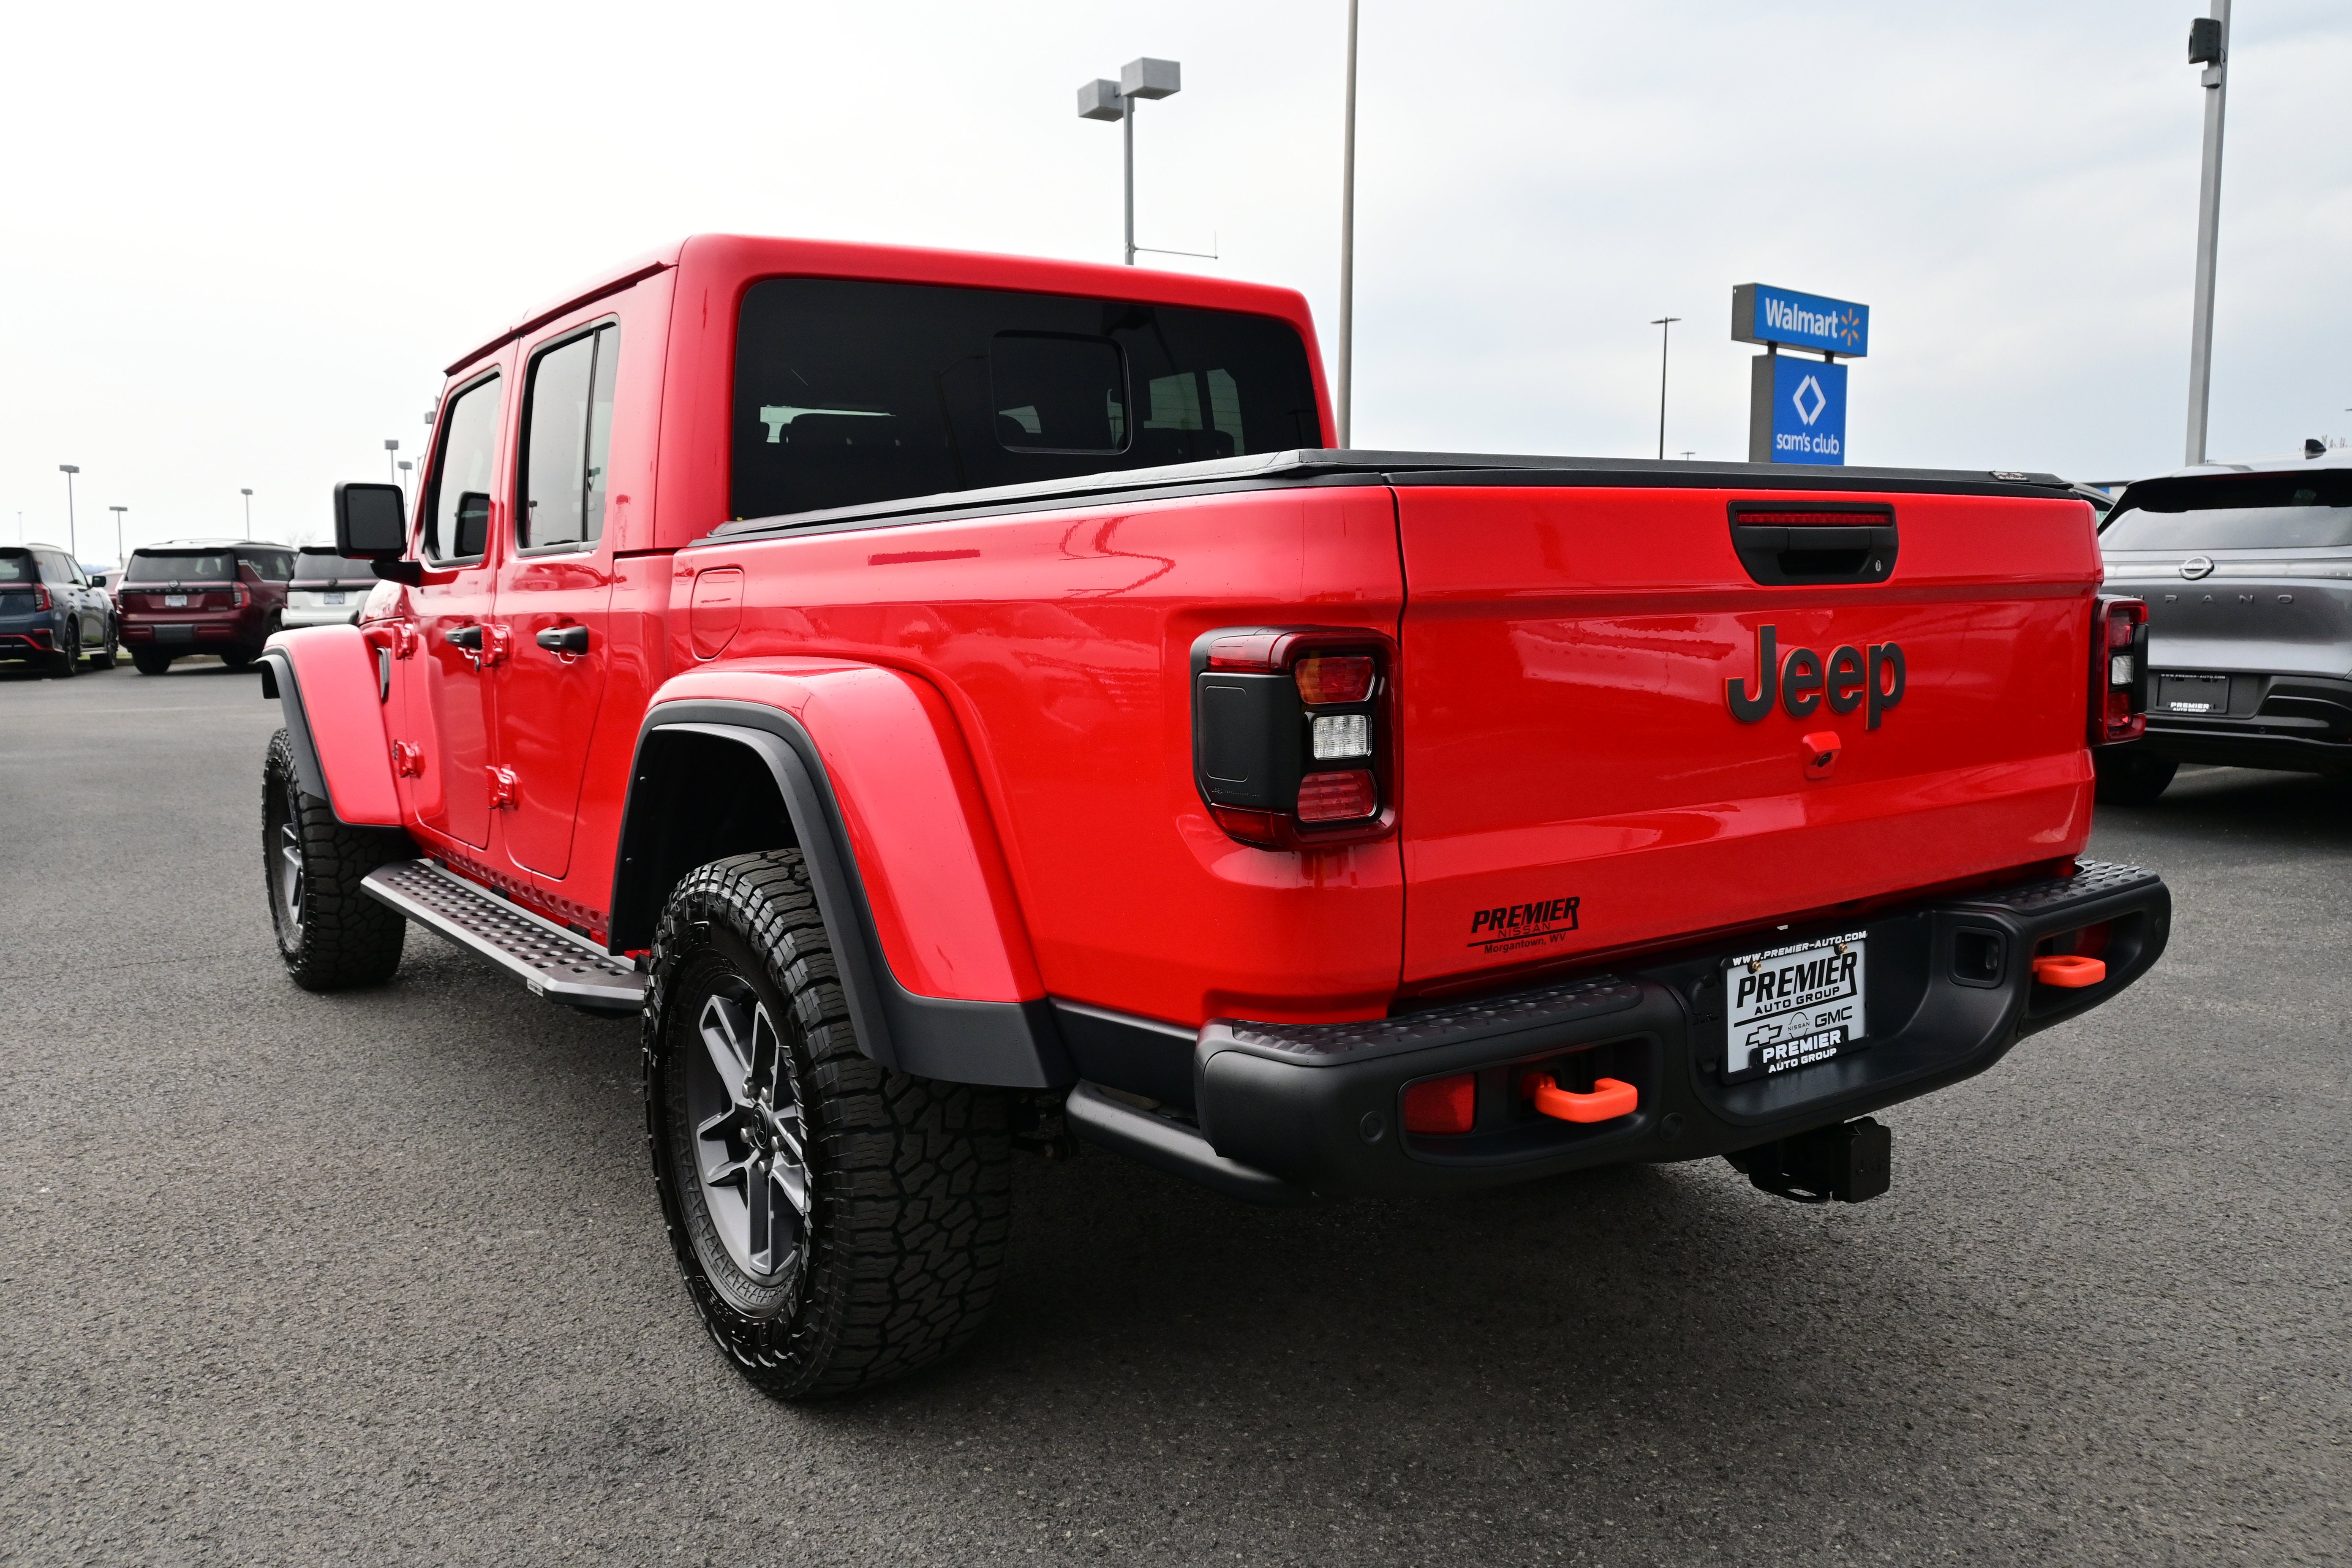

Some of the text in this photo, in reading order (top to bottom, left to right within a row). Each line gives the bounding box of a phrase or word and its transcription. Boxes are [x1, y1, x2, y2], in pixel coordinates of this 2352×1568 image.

[1765, 297, 1838, 338] Walmart
[1776, 432, 1840, 455] sam's club
[1725, 623, 1906, 730] Jeep
[1470, 896, 1581, 934] PREMIER
[1497, 922, 1551, 938] NISSAN
[1484, 932, 1566, 954] Morgantown, WV
[1732, 930, 1867, 966] WWW.PREMIER-AUTO.COM
[1736, 951, 1858, 1009] PREMIER
[1754, 986, 1840, 1016] AUTO GROUP
[1787, 1021, 1810, 1032] NISSAN
[1815, 1005, 1853, 1028] GMC
[1762, 1029, 1841, 1064] PREMIER
[1768, 1047, 1837, 1073] AUTO GROUP
